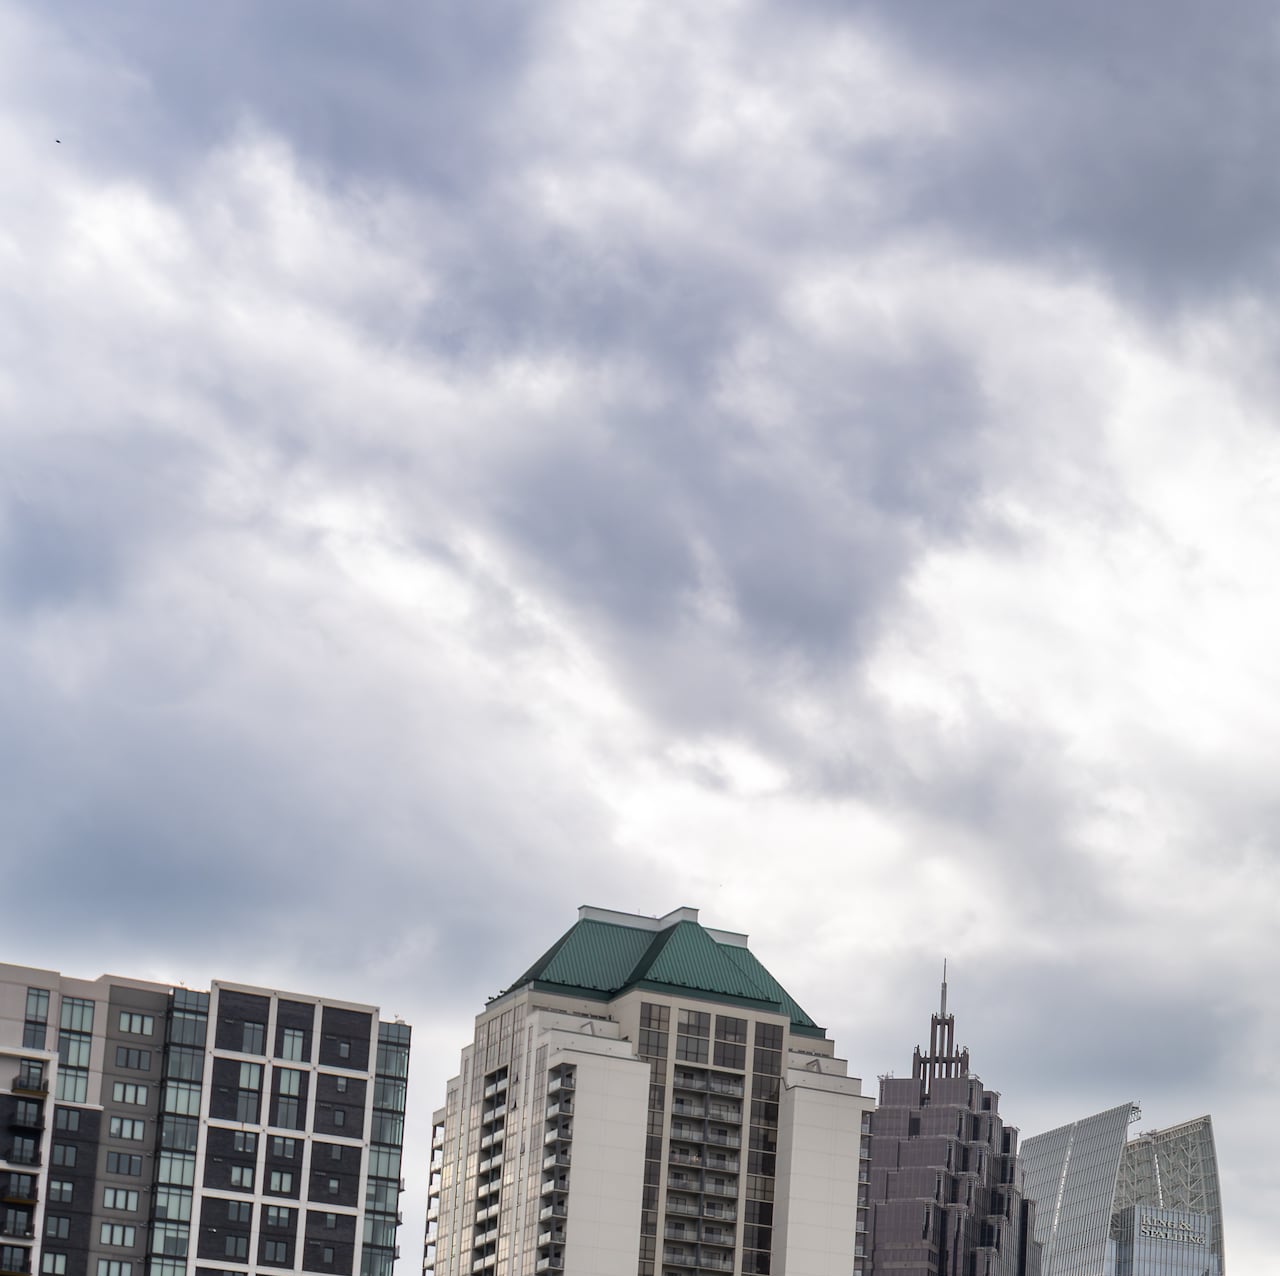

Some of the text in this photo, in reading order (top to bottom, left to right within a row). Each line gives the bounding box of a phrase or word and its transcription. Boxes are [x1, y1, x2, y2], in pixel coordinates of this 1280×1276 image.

[1141, 1215, 1191, 1231] KING &
[1141, 1225, 1205, 1244] SPALDING
